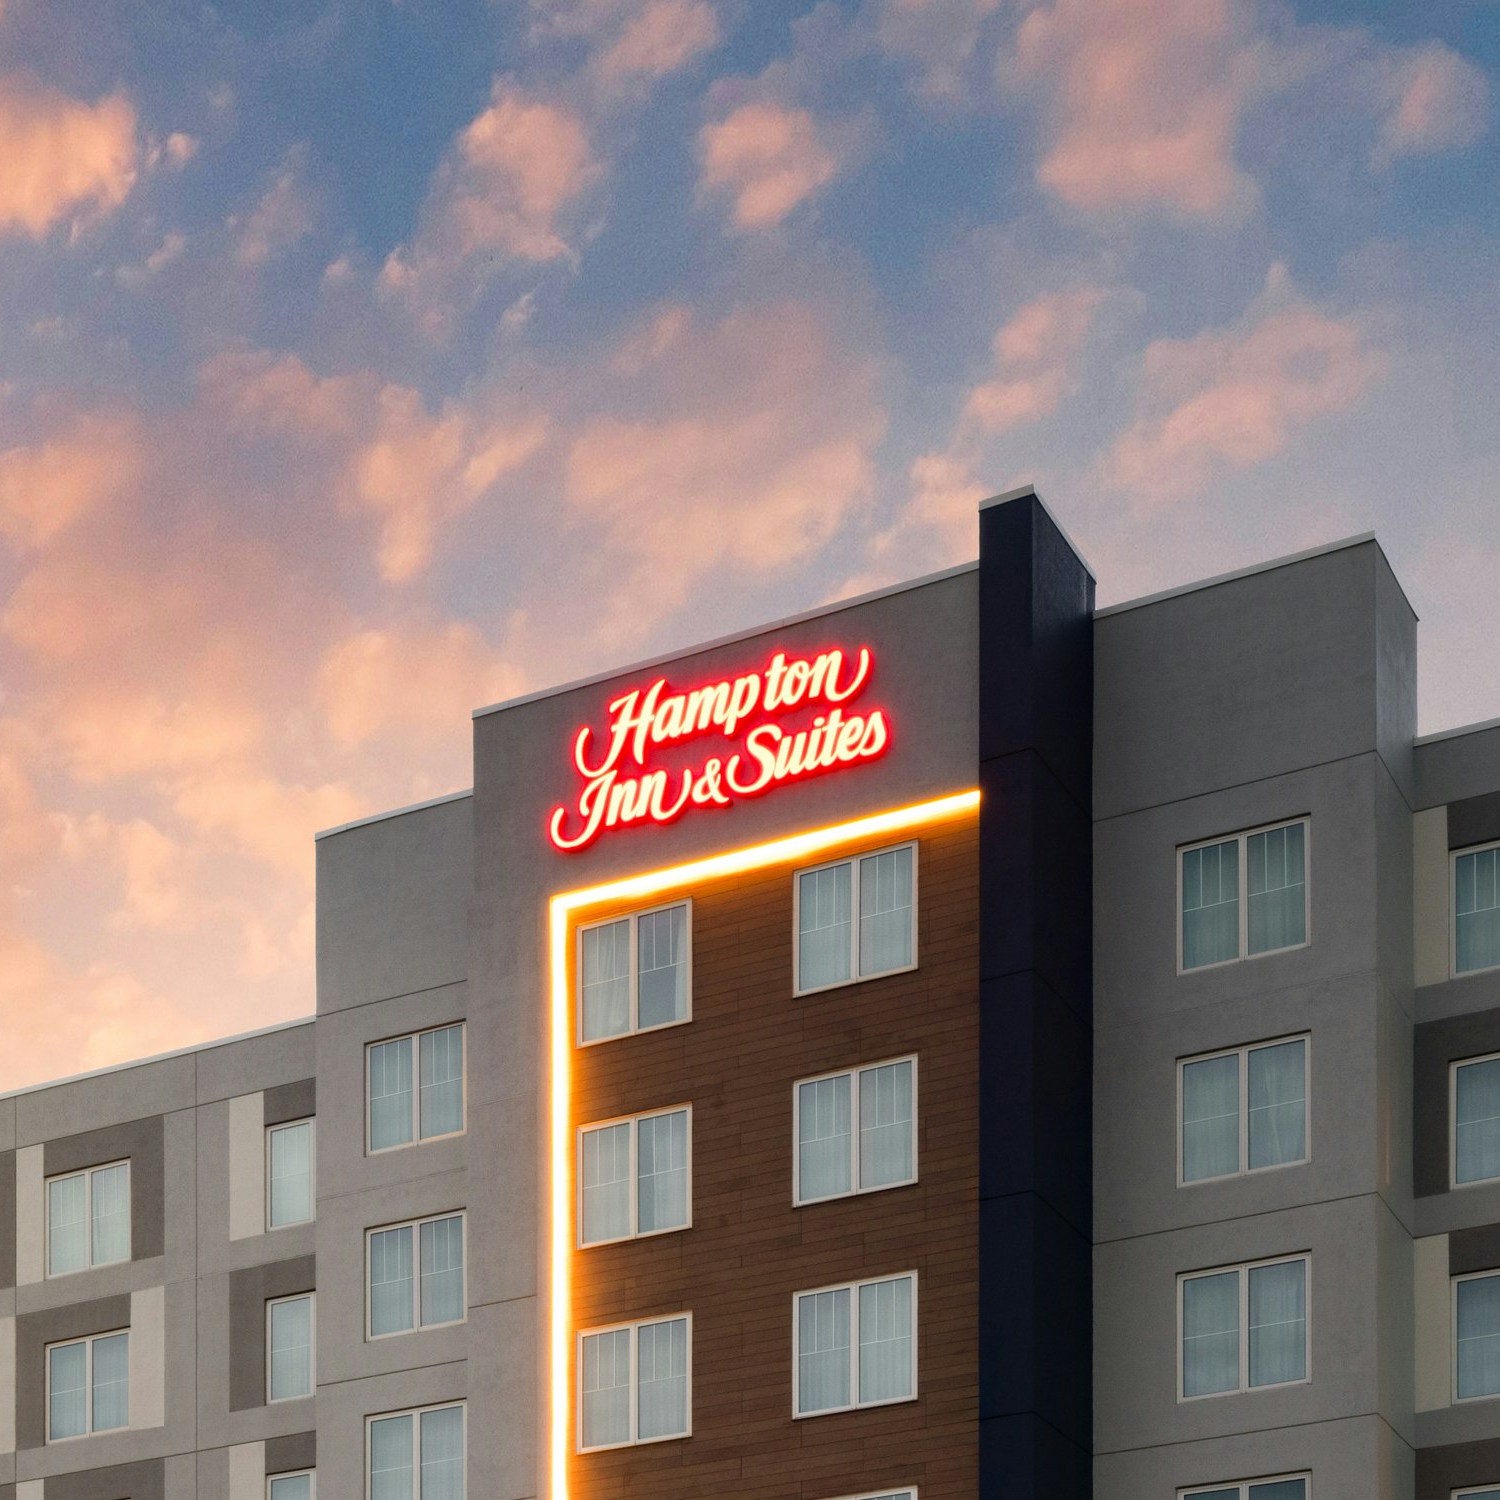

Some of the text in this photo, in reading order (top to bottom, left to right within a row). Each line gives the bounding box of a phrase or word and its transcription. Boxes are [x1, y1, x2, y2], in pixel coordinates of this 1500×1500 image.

[550, 708, 887, 849] Inn & Suites
[575, 648, 870, 778] Hampton
